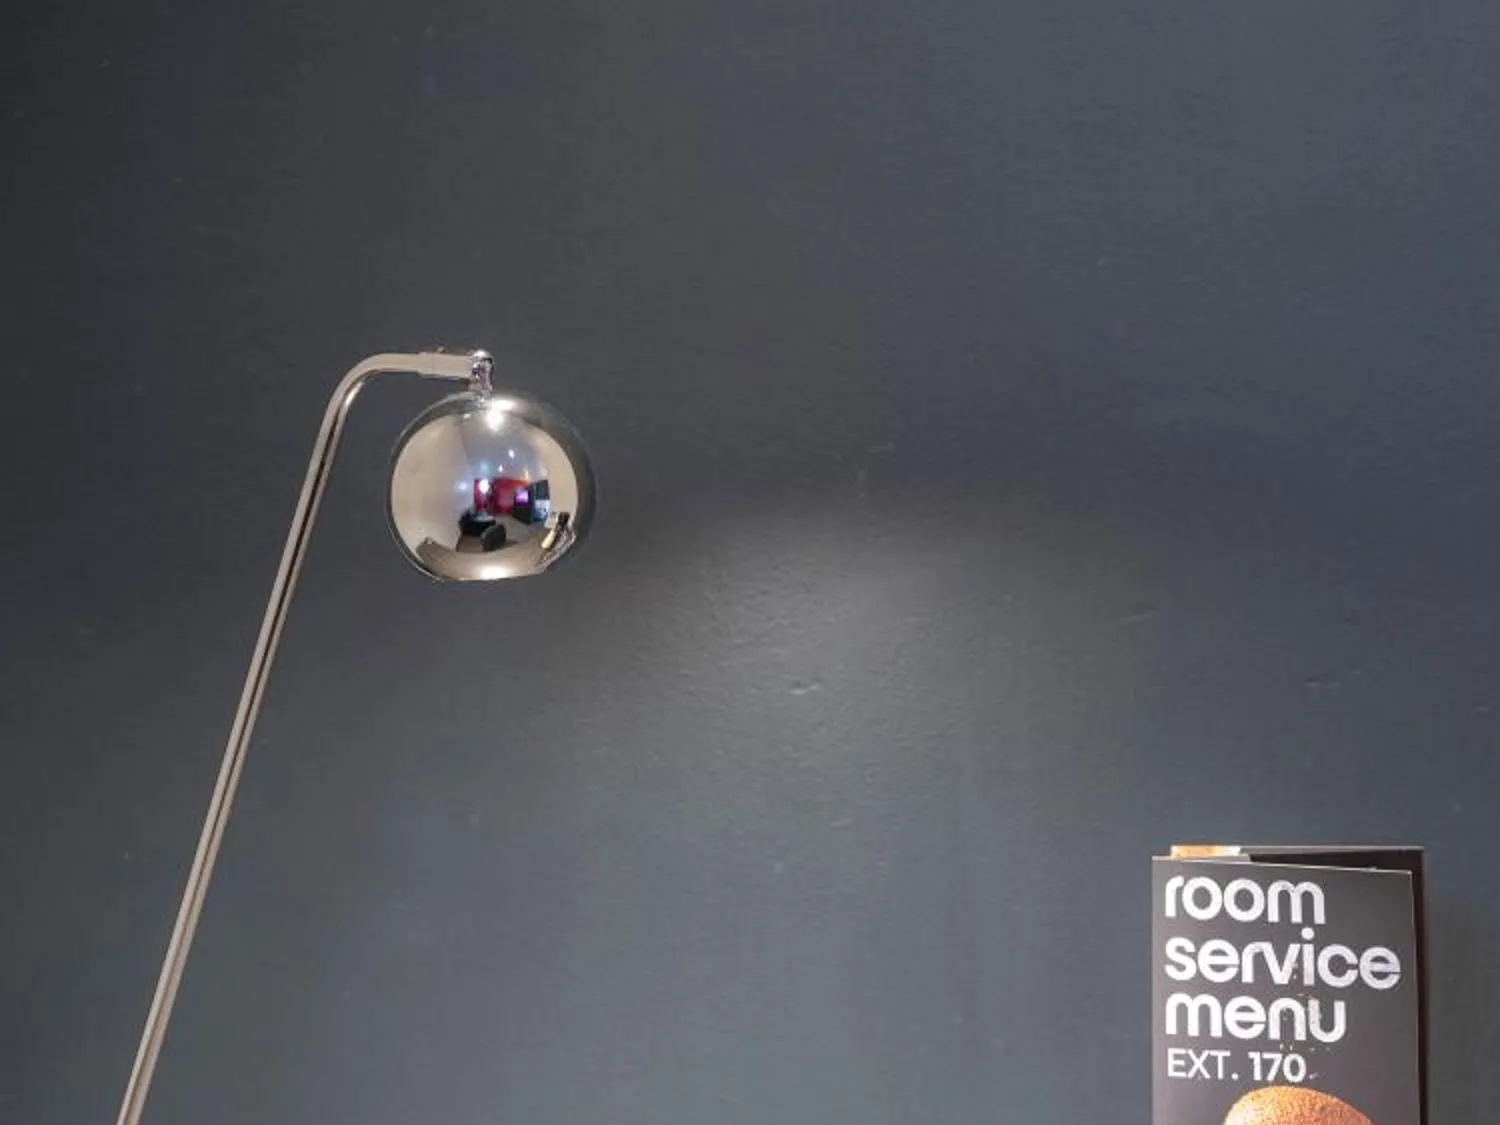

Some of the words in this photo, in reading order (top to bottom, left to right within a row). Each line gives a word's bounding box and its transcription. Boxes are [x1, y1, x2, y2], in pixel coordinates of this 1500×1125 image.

[1164, 876, 1325, 924] room
[1164, 927, 1401, 989] service
[1164, 993, 1346, 1043] menu
[1167, 1048, 1239, 1081] EXT.
[1248, 1051, 1307, 1082] 170
